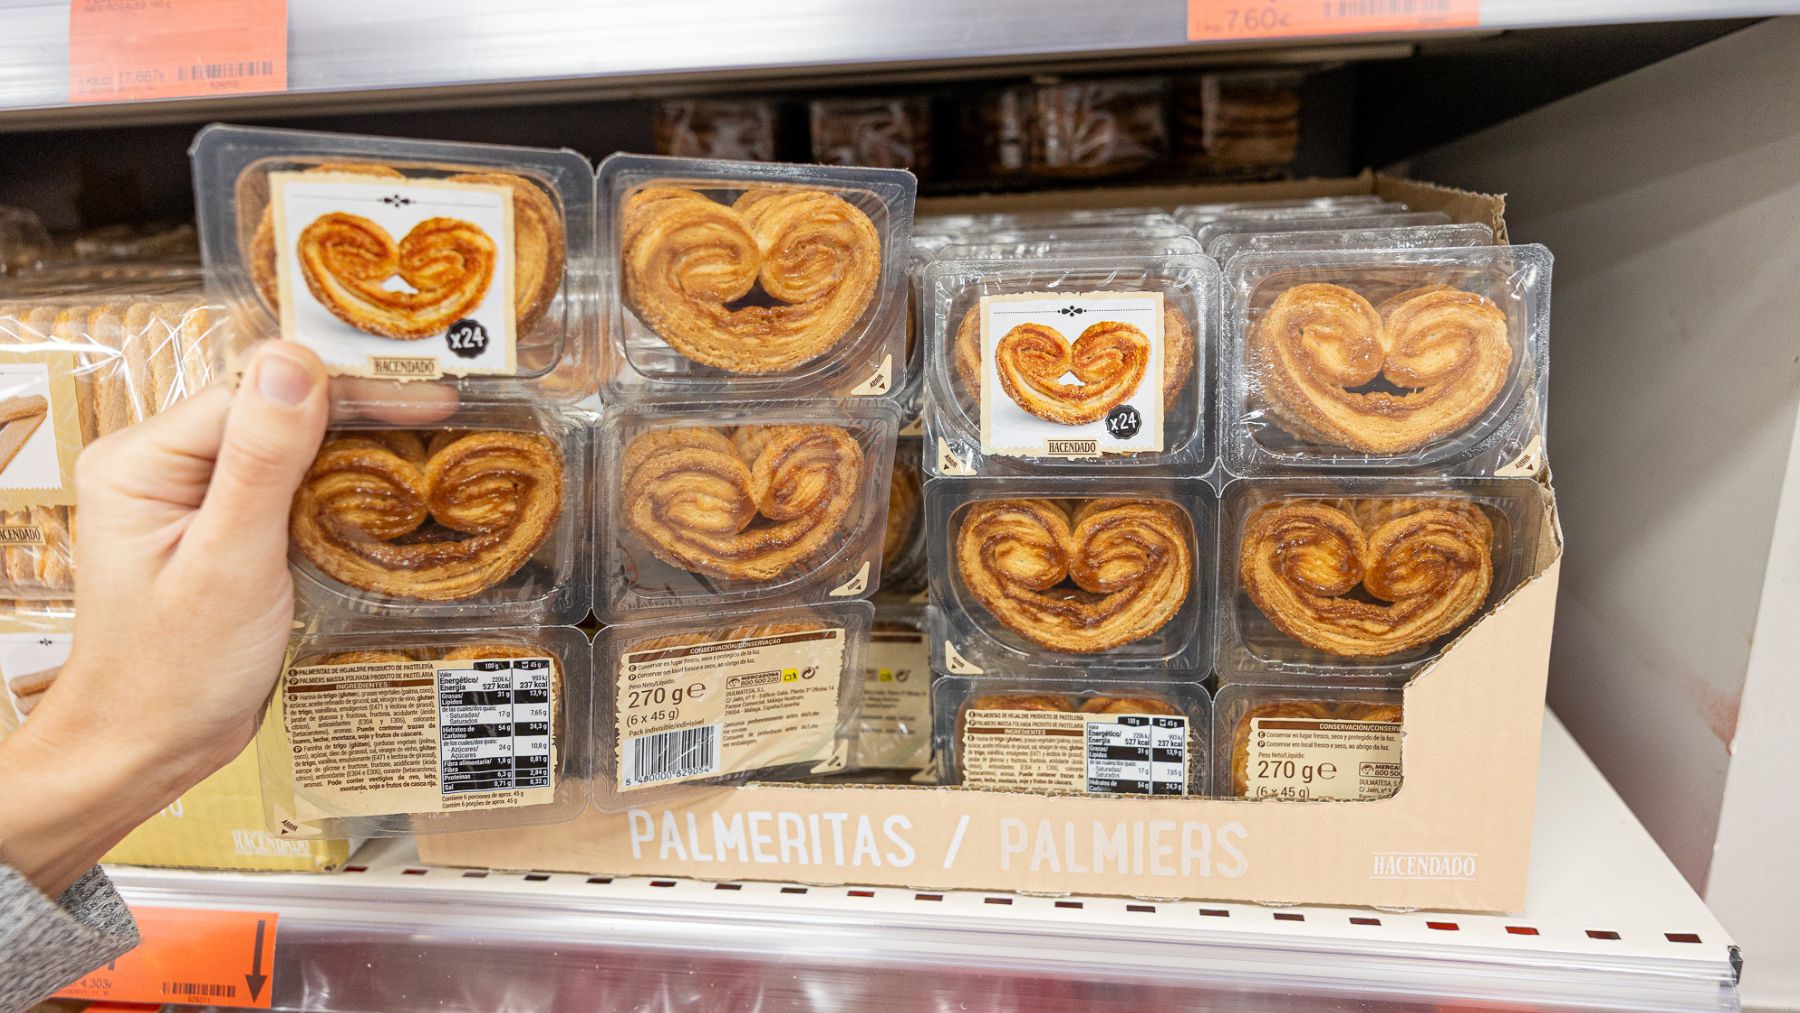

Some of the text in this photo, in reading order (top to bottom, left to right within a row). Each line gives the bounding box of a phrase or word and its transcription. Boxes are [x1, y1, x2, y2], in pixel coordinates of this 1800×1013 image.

[450, 326, 484, 349] x24
[375, 359, 435, 373] HACENDADO
[870, 373, 884, 388] ABRIR
[1109, 411, 1137, 431] x24
[1048, 442, 1096, 453] HACENDADO
[944, 454, 958, 468] ABRIR
[1515, 454, 1531, 469] ABRIR
[0, 528, 42, 541] ACENDADO
[340, 665, 366, 673] HOJALDRE
[404, 662, 433, 670] PASTELERÍA
[403, 671, 433, 679] PASTELARIA
[741, 671, 779, 680] MERCADONA
[440, 676, 478, 685] Energético/
[520, 680, 548, 689] 237 kcal
[440, 683, 466, 692] Energía
[530, 689, 542, 697] 13,9
[628, 687, 666, 709] 270
[672, 687, 683, 706] g
[530, 709, 542, 717] 7,65
[626, 707, 680, 728] (6 x 45 g)
[443, 732, 467, 740] Carbono
[629, 729, 644, 737] Pack
[1089, 730, 1121, 738] Energético/
[1300, 732, 1312, 740] lugar
[1314, 732, 1331, 740] fresco,
[1348, 734, 1372, 742] protegido
[1138, 738, 1150, 746] kcal
[1170, 740, 1183, 748] kcal
[1266, 740, 1291, 748] Conservar
[1356, 743, 1372, 751] abrigo
[451, 745, 478, 753] Azúcares/
[1259, 751, 1270, 759] Peso
[459, 758, 492, 766] alimentaria/
[443, 766, 459, 774] Fibra
[1257, 760, 1295, 779] 270
[1302, 764, 1313, 783] g
[637, 771, 672, 784] 480000
[676, 768, 710, 777] 829054
[493, 780, 506, 788] 0,71
[1281, 786, 1296, 797] 45
[1299, 786, 1310, 798] g)
[628, 809, 916, 867] PALMERITAS
[1000, 817, 1249, 878] PALMIERS
[1373, 855, 1477, 877] HACENDADO
